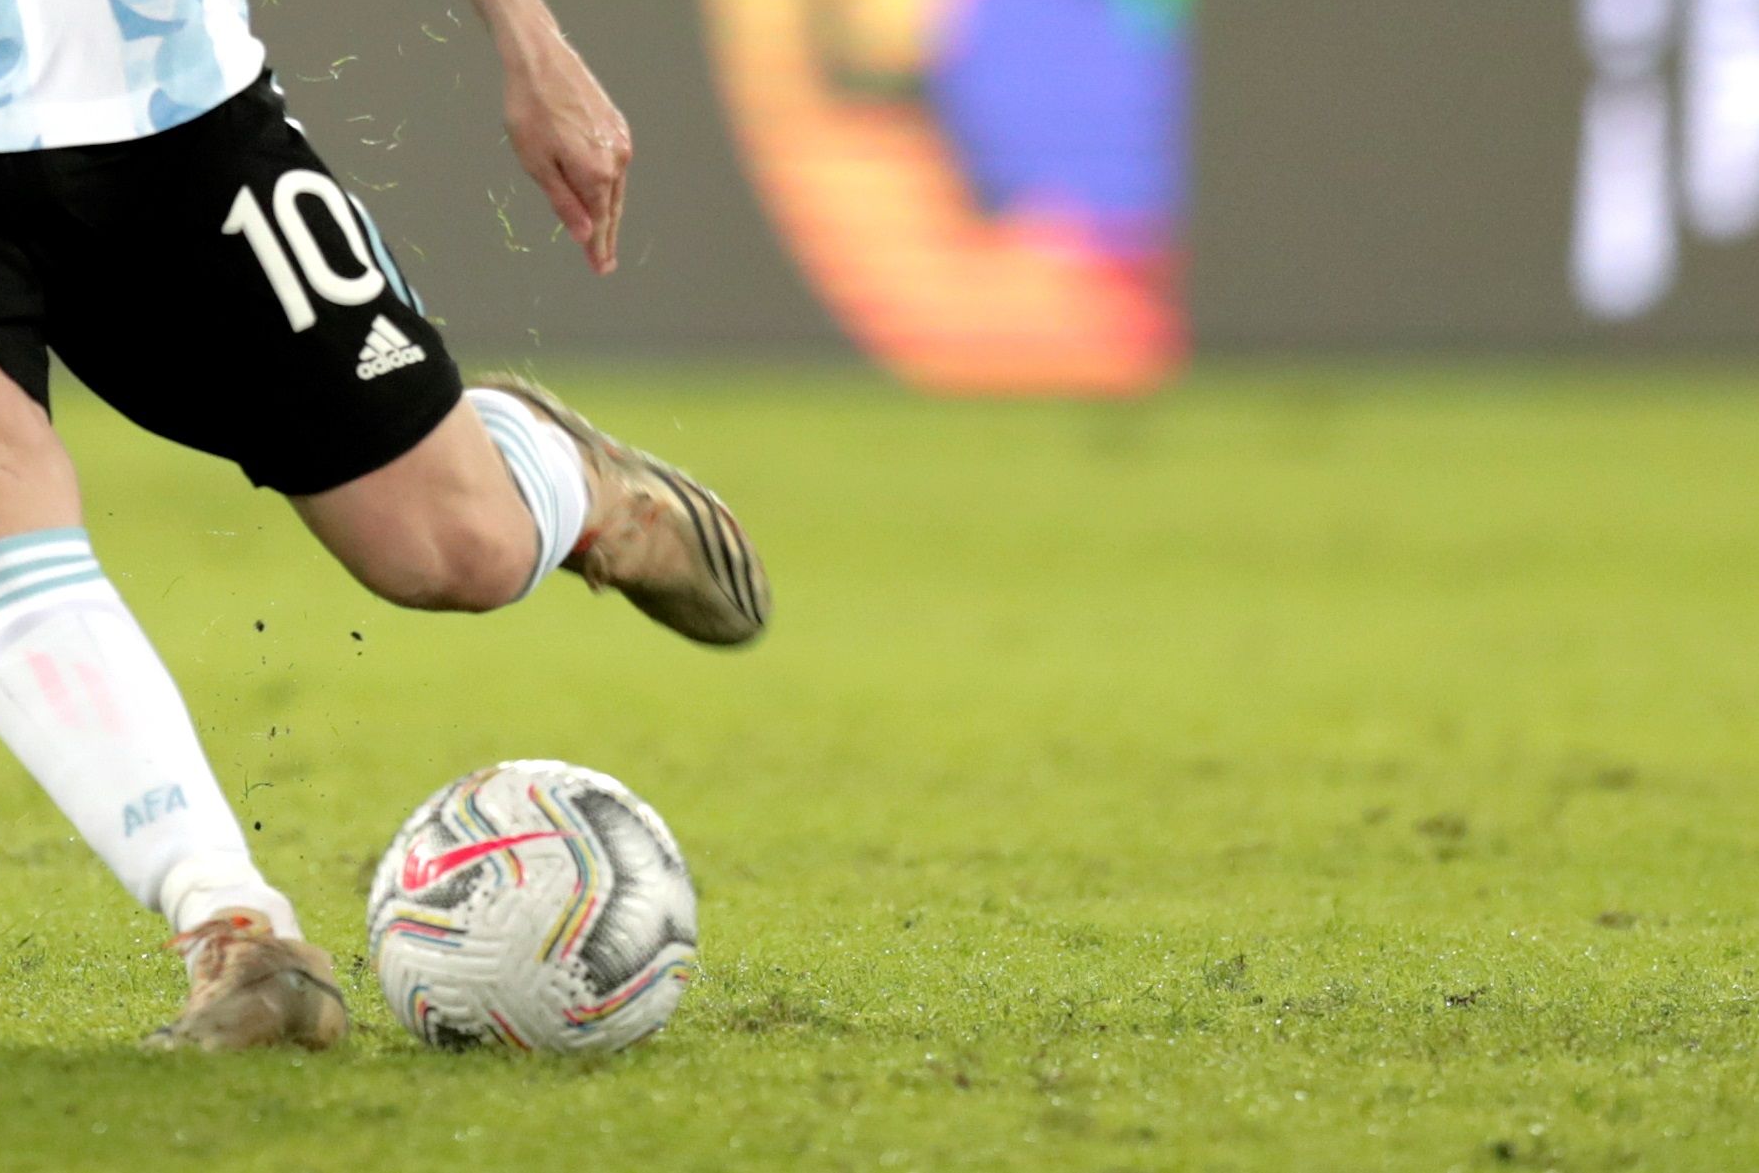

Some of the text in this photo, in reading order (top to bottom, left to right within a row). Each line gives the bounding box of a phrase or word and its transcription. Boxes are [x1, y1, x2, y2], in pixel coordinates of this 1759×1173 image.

[220, 168, 386, 333] 10
[356, 344, 426, 380] adidas
[123, 783, 188, 838] AFA
